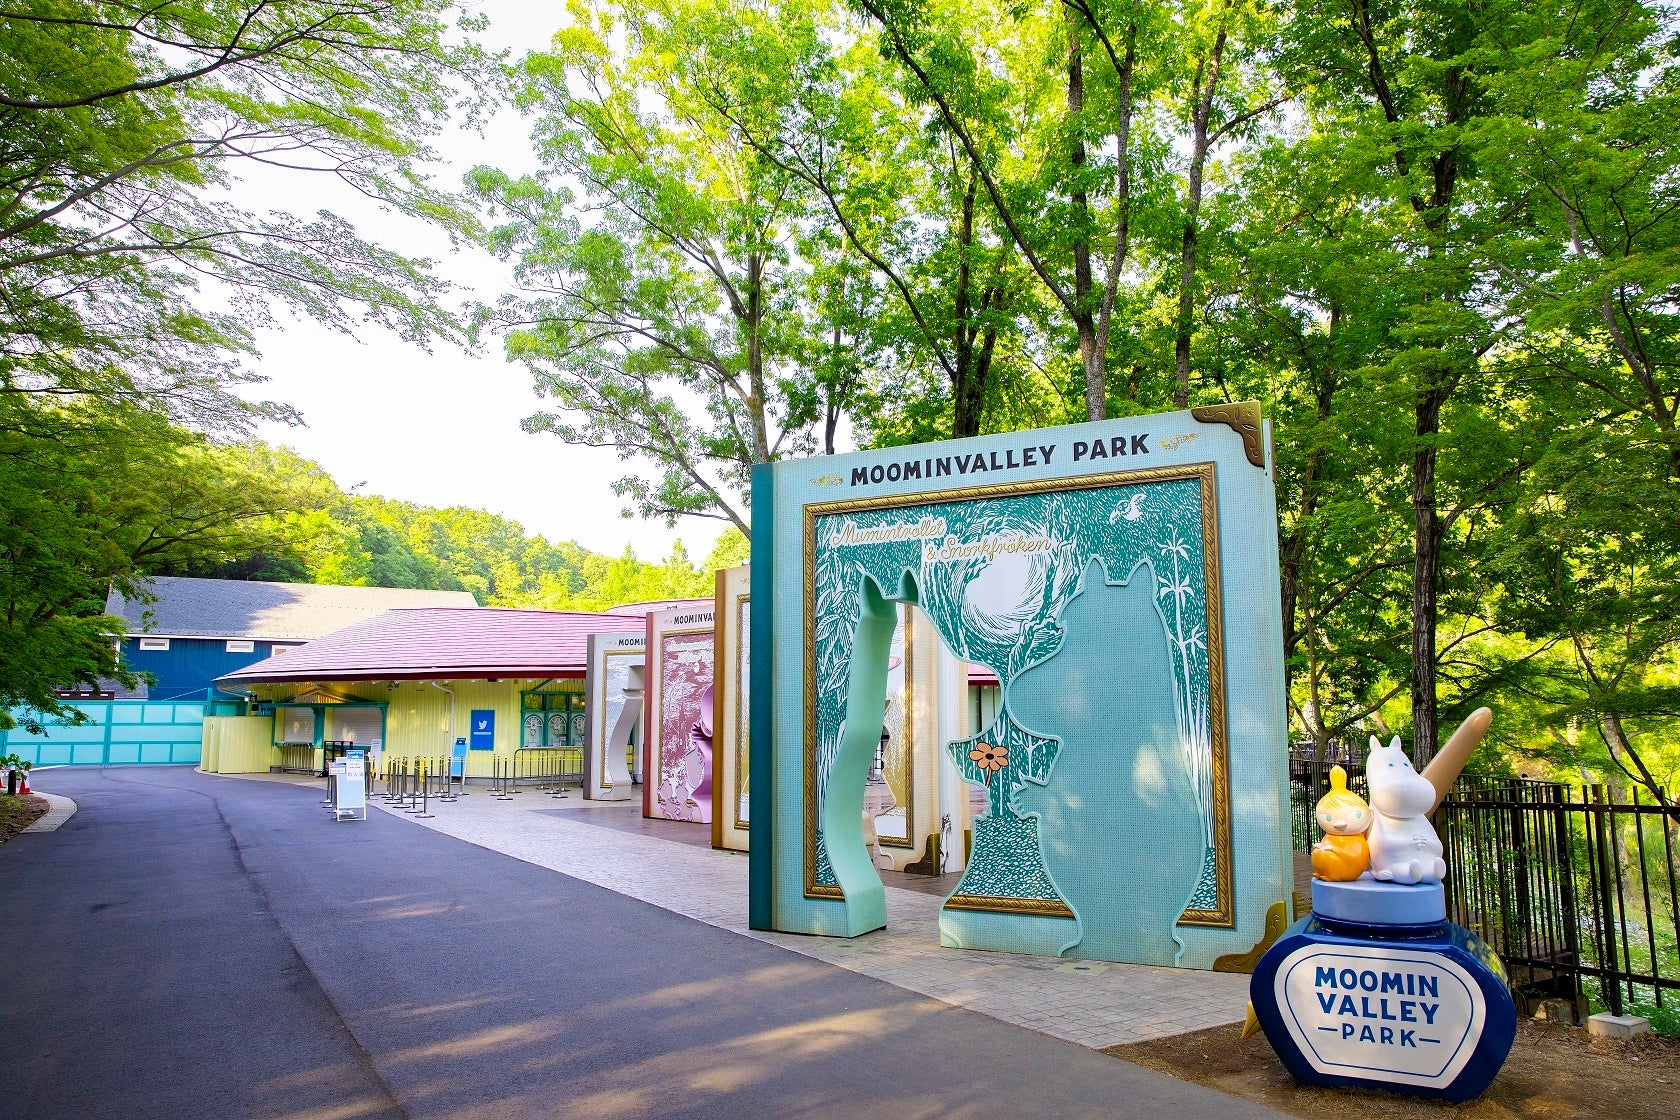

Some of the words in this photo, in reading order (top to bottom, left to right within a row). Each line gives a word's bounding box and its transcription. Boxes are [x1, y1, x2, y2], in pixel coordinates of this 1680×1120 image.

[850, 444, 1056, 487] MOOMINVALLEY
[1073, 433, 1150, 462] PARK
[832, 519, 946, 546] Mumintrollet
[926, 546, 937, 560] &
[941, 536, 1052, 561] Snorkfröken
[1314, 966, 1439, 998] MOOMIN
[1316, 992, 1440, 1025] VALLEY
[1342, 1022, 1417, 1048] PARK
